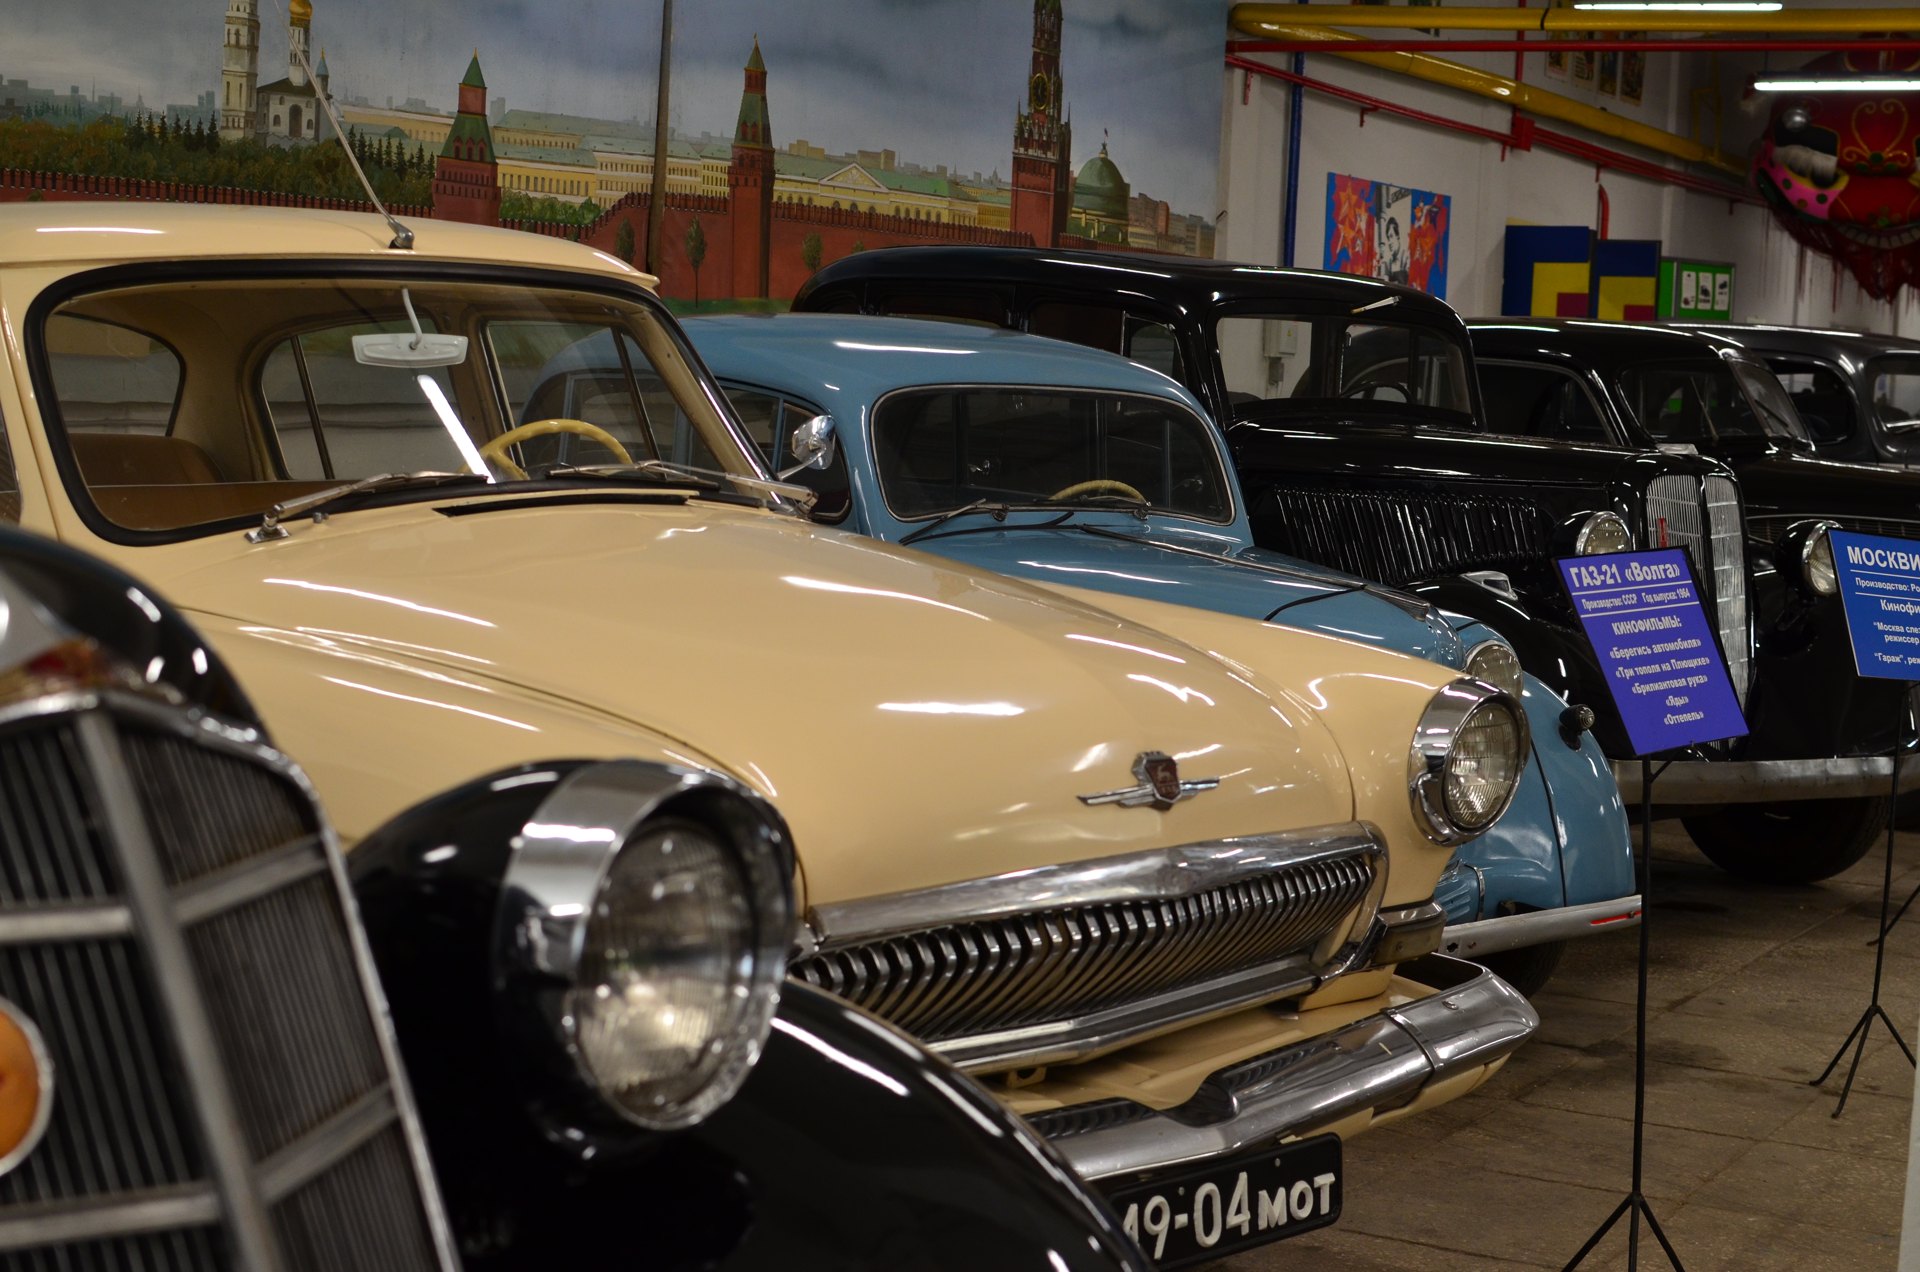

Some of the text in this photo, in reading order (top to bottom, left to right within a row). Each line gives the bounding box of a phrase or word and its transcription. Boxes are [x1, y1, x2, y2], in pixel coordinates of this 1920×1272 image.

[1569, 561, 1680, 588] ГАЗ-21 «Волга»
[1855, 577, 1910, 592] Производство:
[1621, 593, 1638, 605] СССР
[1641, 591, 1654, 604] Год
[1676, 587, 1691, 599] 1964
[1611, 615, 1682, 635] КИНОФИЛЬМЫ:
[1609, 638, 1702, 660] «Берегись автомобиля»
[1615, 656, 1710, 680] «Три тополя на Плющихе»
[1686, 674, 1708, 688] рука»
[1663, 711, 1704, 725] «Оттепель»
